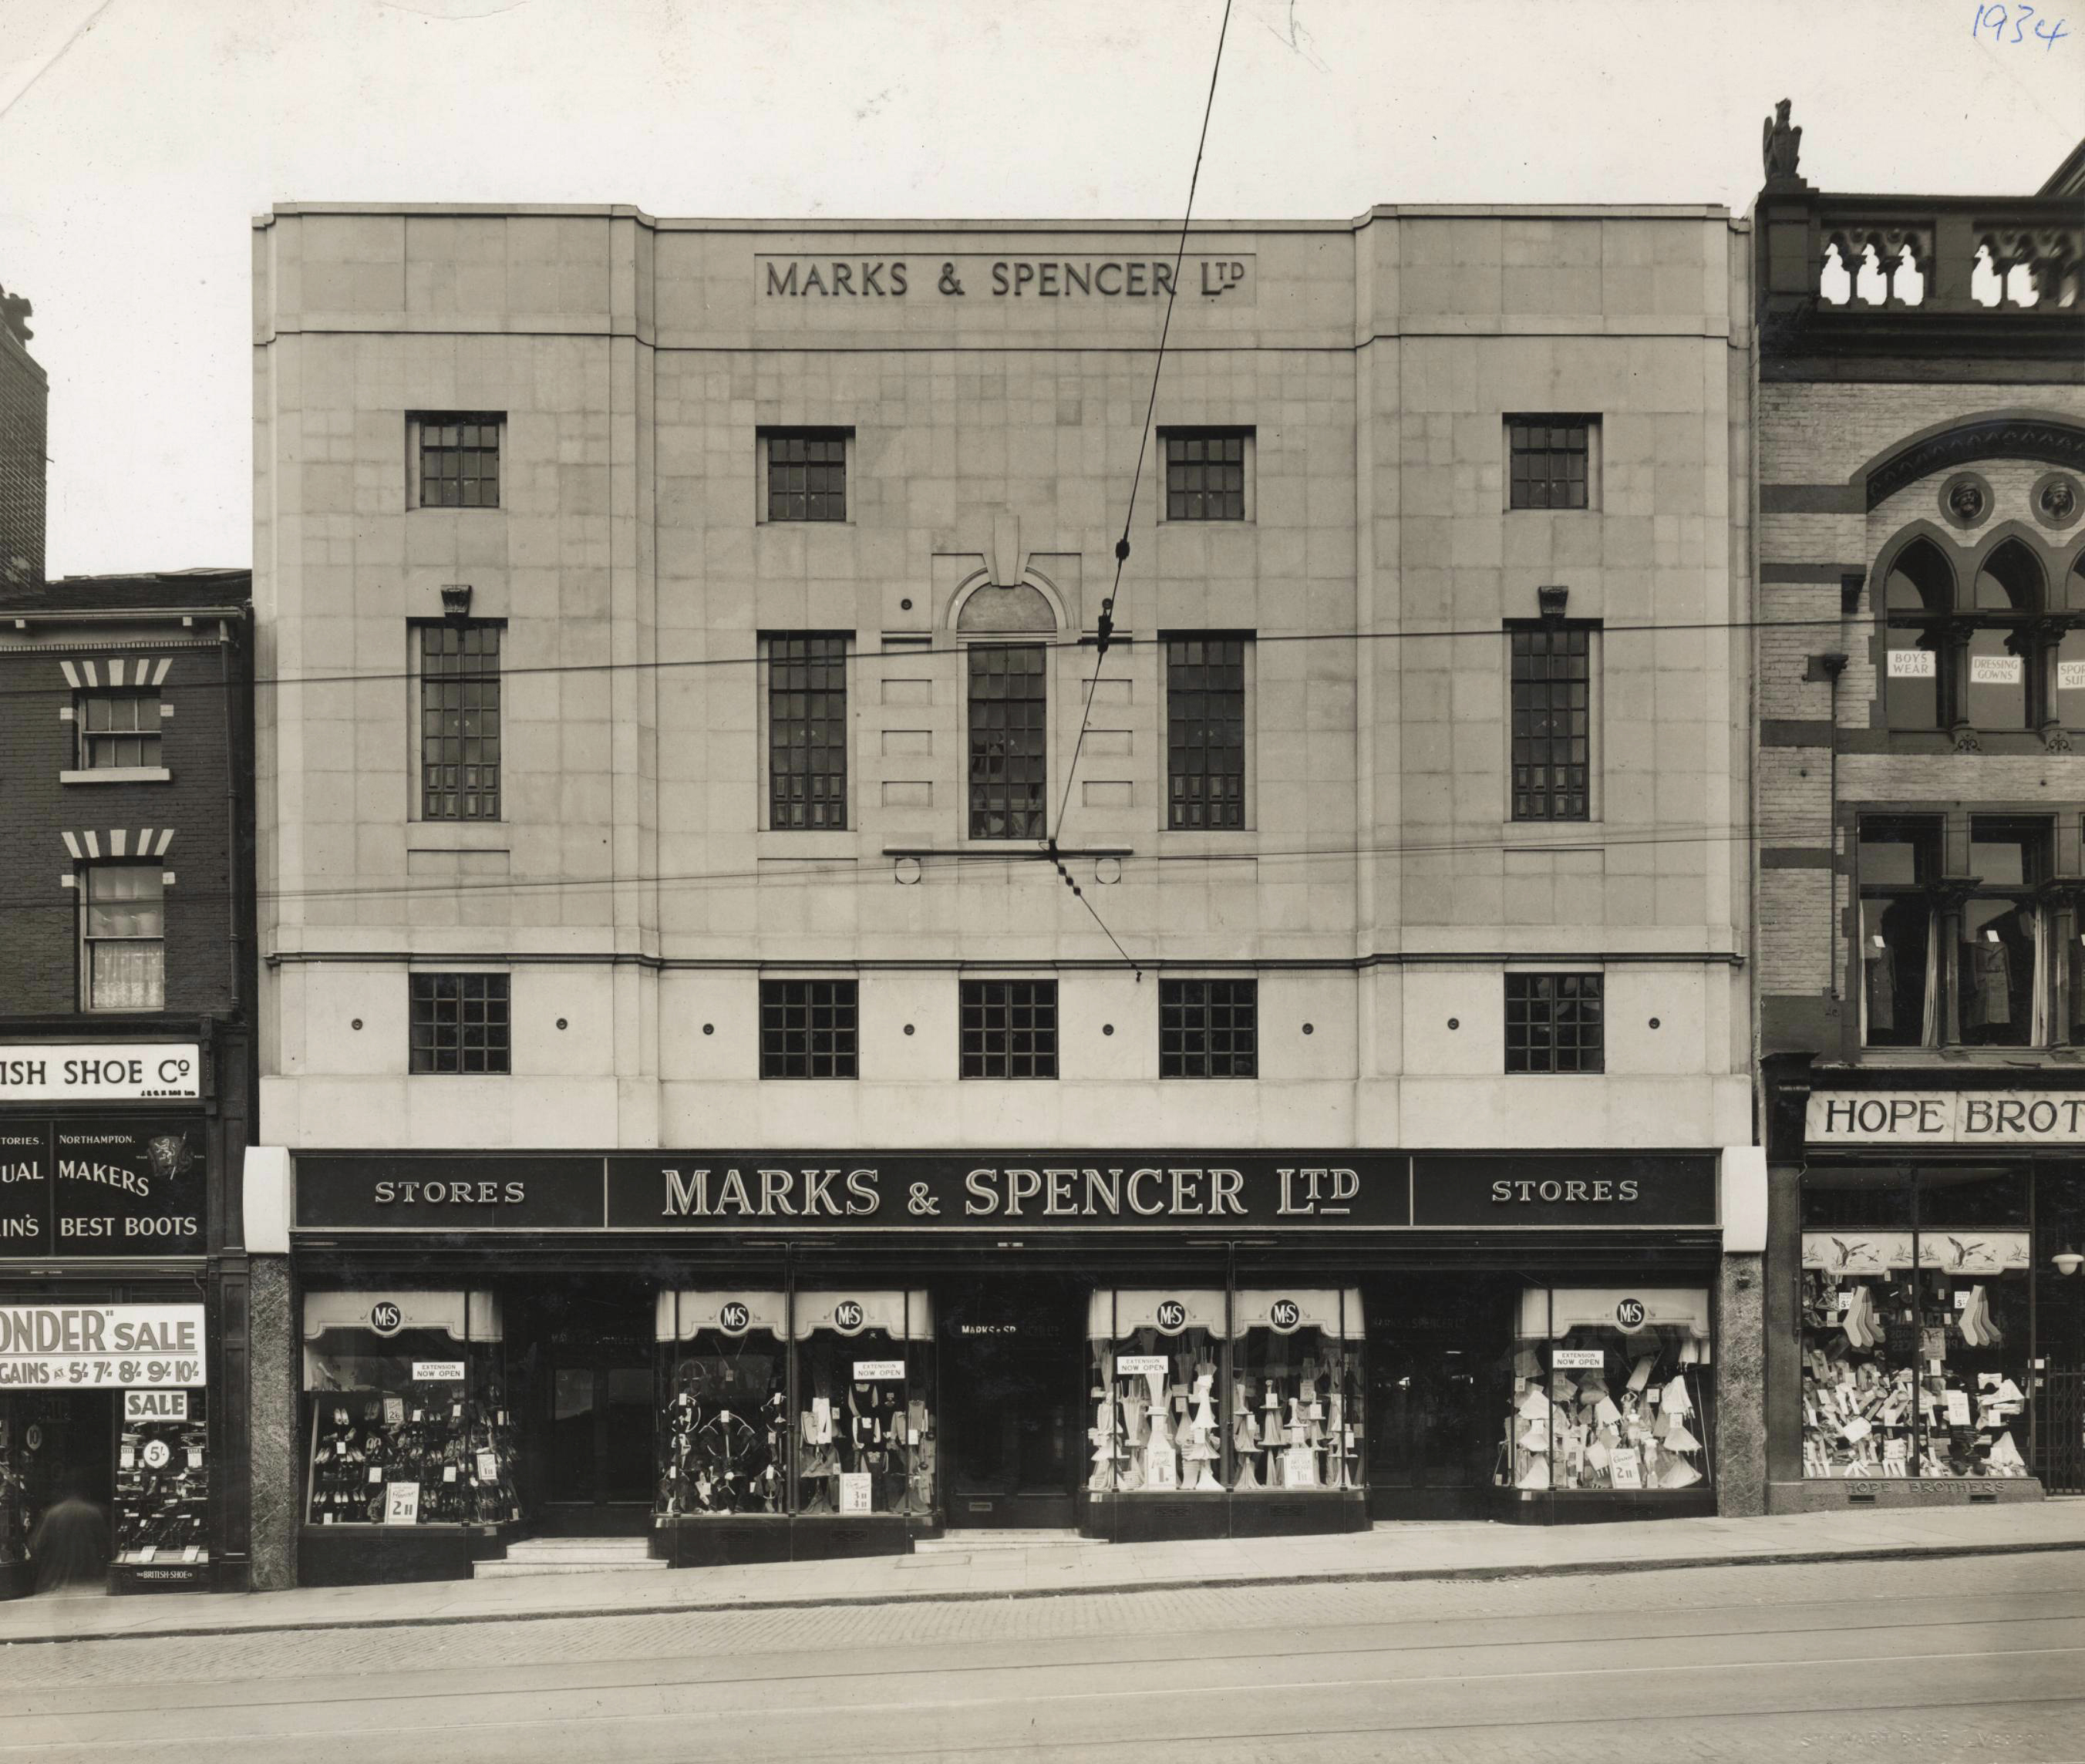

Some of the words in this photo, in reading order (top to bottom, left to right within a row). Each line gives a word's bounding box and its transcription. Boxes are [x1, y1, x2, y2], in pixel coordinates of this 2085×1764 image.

[1972, 4, 2069, 51] 1934
[766, 261, 908, 296] MARKS
[938, 262, 965, 296] &
[991, 261, 1177, 296] SPENCER
[1893, 664, 1928, 674] WEAR
[1895, 653, 1928, 663] BOYS
[1974, 658, 2018, 669] DRESSING
[1978, 670, 2013, 680] GOWNS
[0, 1061, 46, 1085] ISH
[64, 1060, 143, 1084] SHOE
[1825, 1100, 1945, 1133] HOPE
[59, 1160, 150, 1197] MAKERS
[375, 1181, 526, 1204] STORES
[662, 1169, 881, 1216] MARKS
[908, 1182, 941, 1216] &
[965, 1169, 1249, 1216] SPENCER
[1492, 1180, 1639, 1202] STORES
[61, 1217, 115, 1237] BEST
[125, 1217, 197, 1236] BOOTS
[114, 1322, 195, 1351] SALE
[0, 1362, 49, 1384] GAINS
[53, 1367, 65, 1379] AT
[128, 1394, 185, 1416] SALE
[1844, 1482, 1892, 1493] HOPE
[1908, 1481, 2006, 1493] BROTHERS
